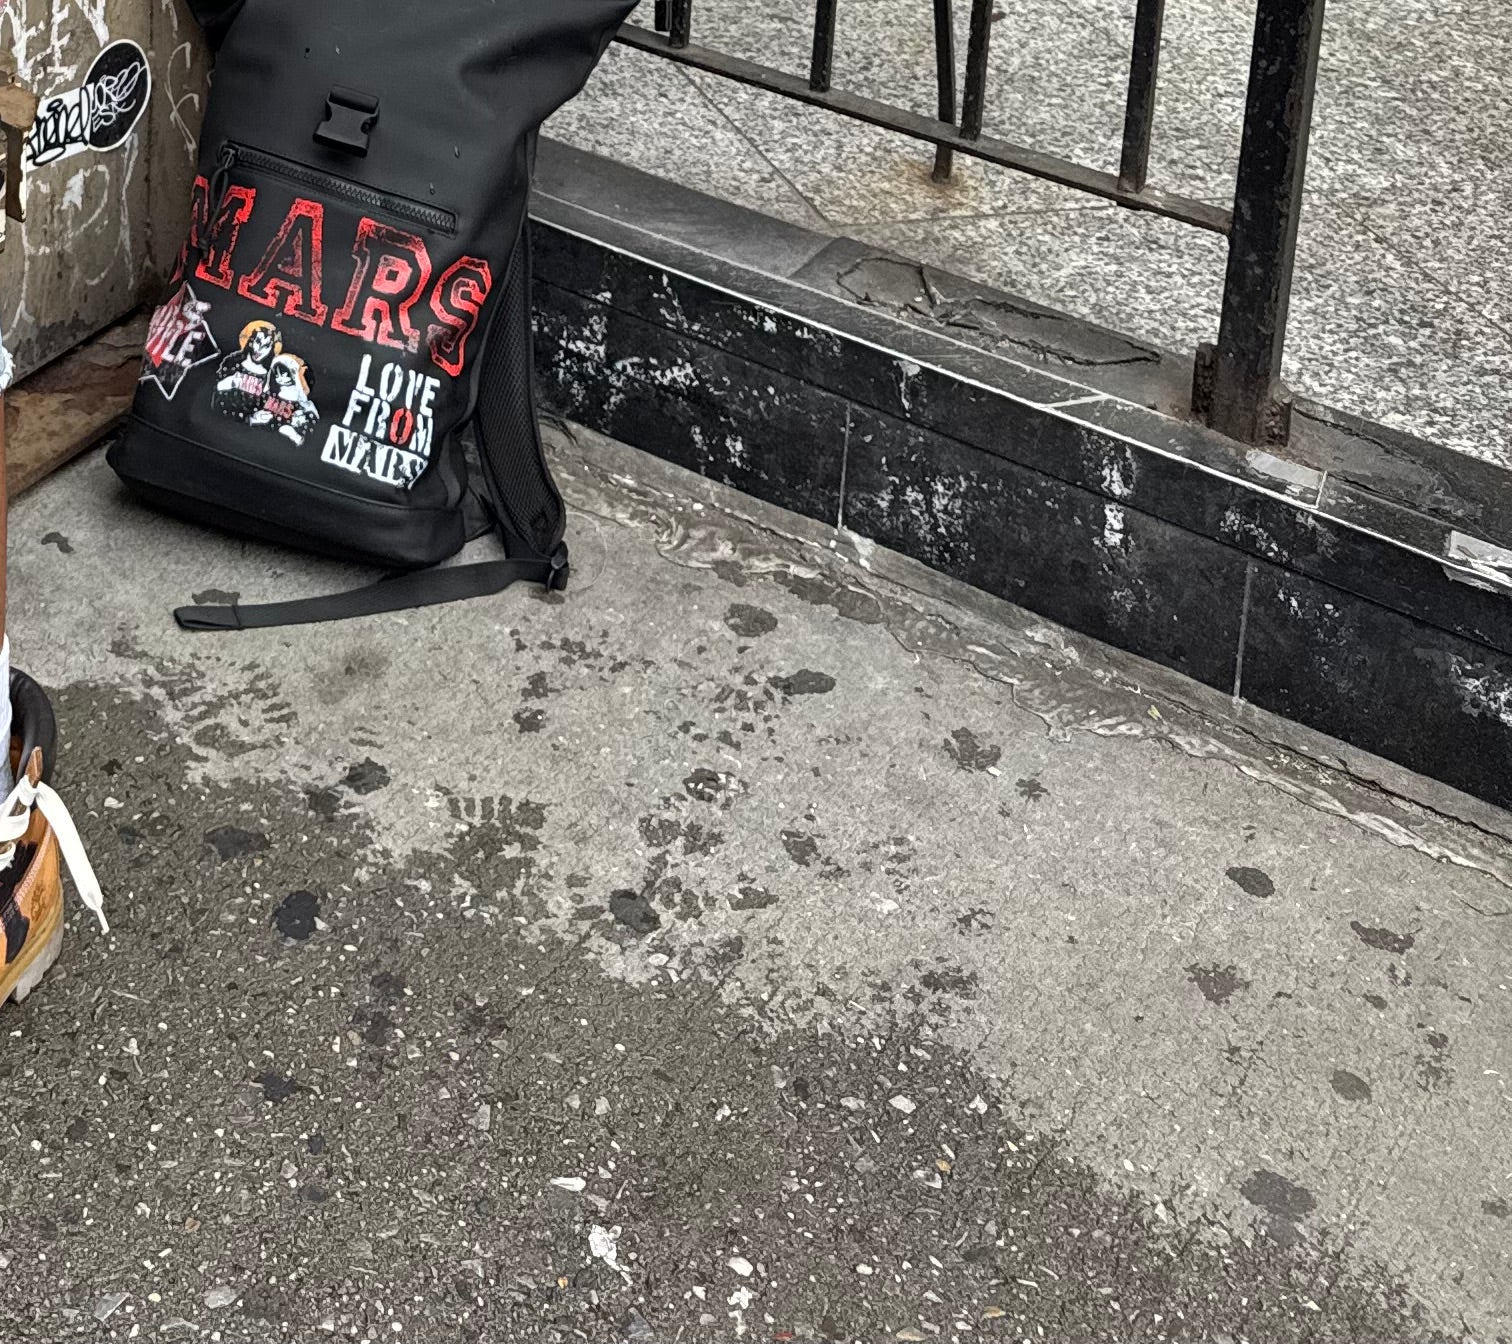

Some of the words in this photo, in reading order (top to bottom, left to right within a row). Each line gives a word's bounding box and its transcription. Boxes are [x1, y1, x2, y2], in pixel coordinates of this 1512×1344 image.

[190, 174, 493, 378] MARS
[355, 353, 441, 415] LOVE
[341, 388, 435, 457] FROM
